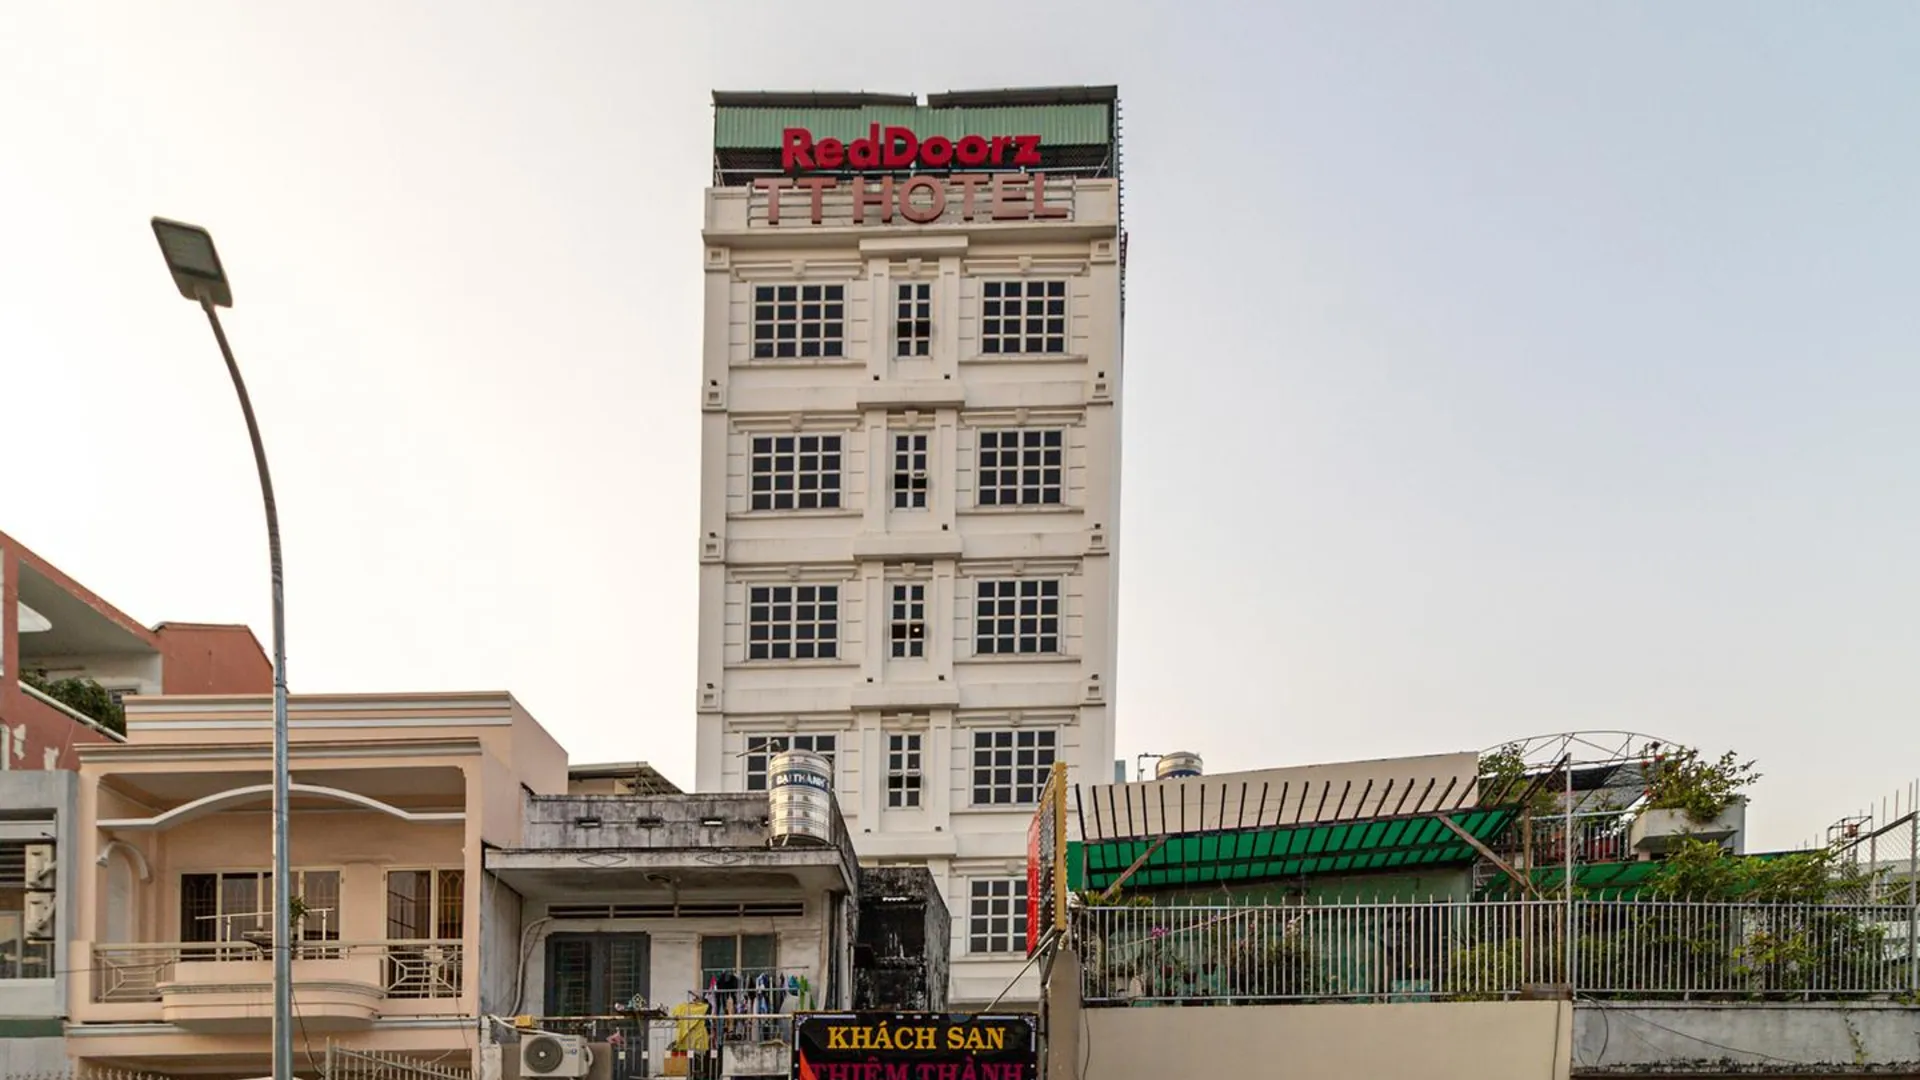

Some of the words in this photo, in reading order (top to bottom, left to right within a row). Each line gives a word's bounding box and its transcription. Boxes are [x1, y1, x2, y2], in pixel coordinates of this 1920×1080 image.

[782, 122, 1042, 170] RedDoorz
[754, 177, 837, 224] TT
[853, 172, 1068, 224] HOTEL
[827, 1020, 937, 1049] KHÁCH
[947, 1026, 1006, 1055] SẠN
[914, 1055, 1023, 1080] THÀNH
